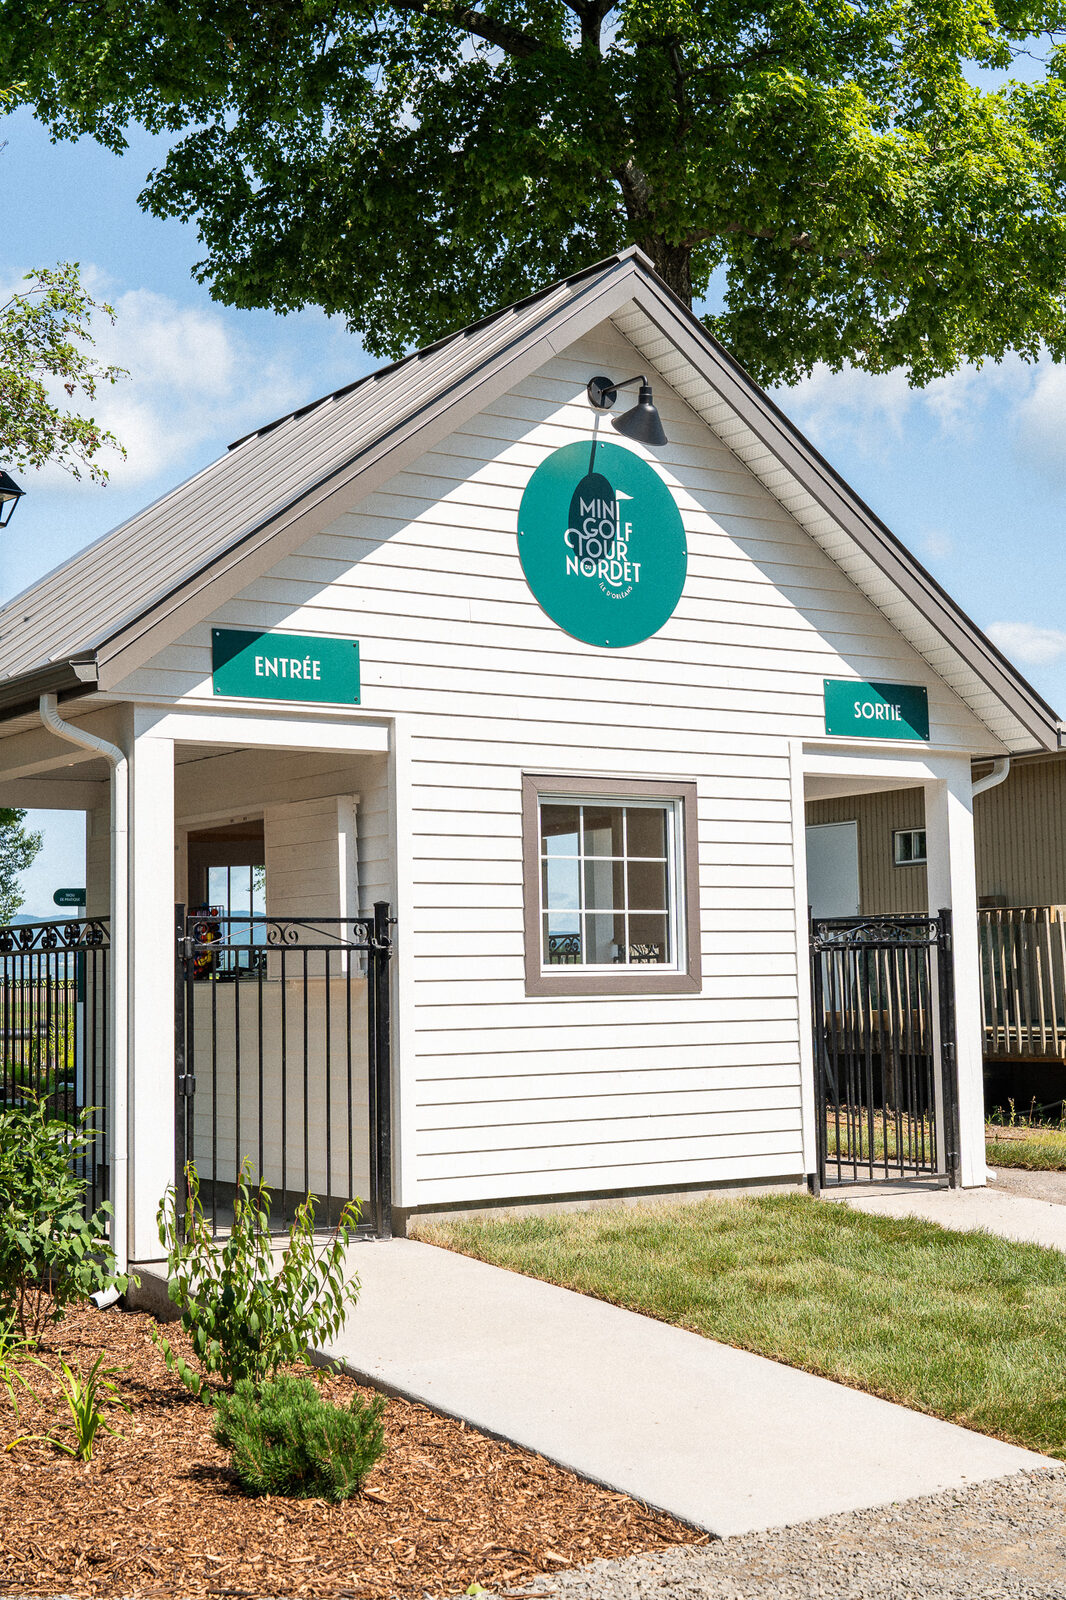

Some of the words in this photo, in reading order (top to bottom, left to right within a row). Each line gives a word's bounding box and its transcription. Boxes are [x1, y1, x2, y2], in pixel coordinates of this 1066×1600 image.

[579, 496, 620, 521] MINI
[582, 517, 633, 542] GOLF
[563, 528, 628, 562] TOUR
[565, 554, 642, 587] NORDET
[254, 655, 322, 681] ENTRÉE
[853, 701, 902, 721] SORTIE
